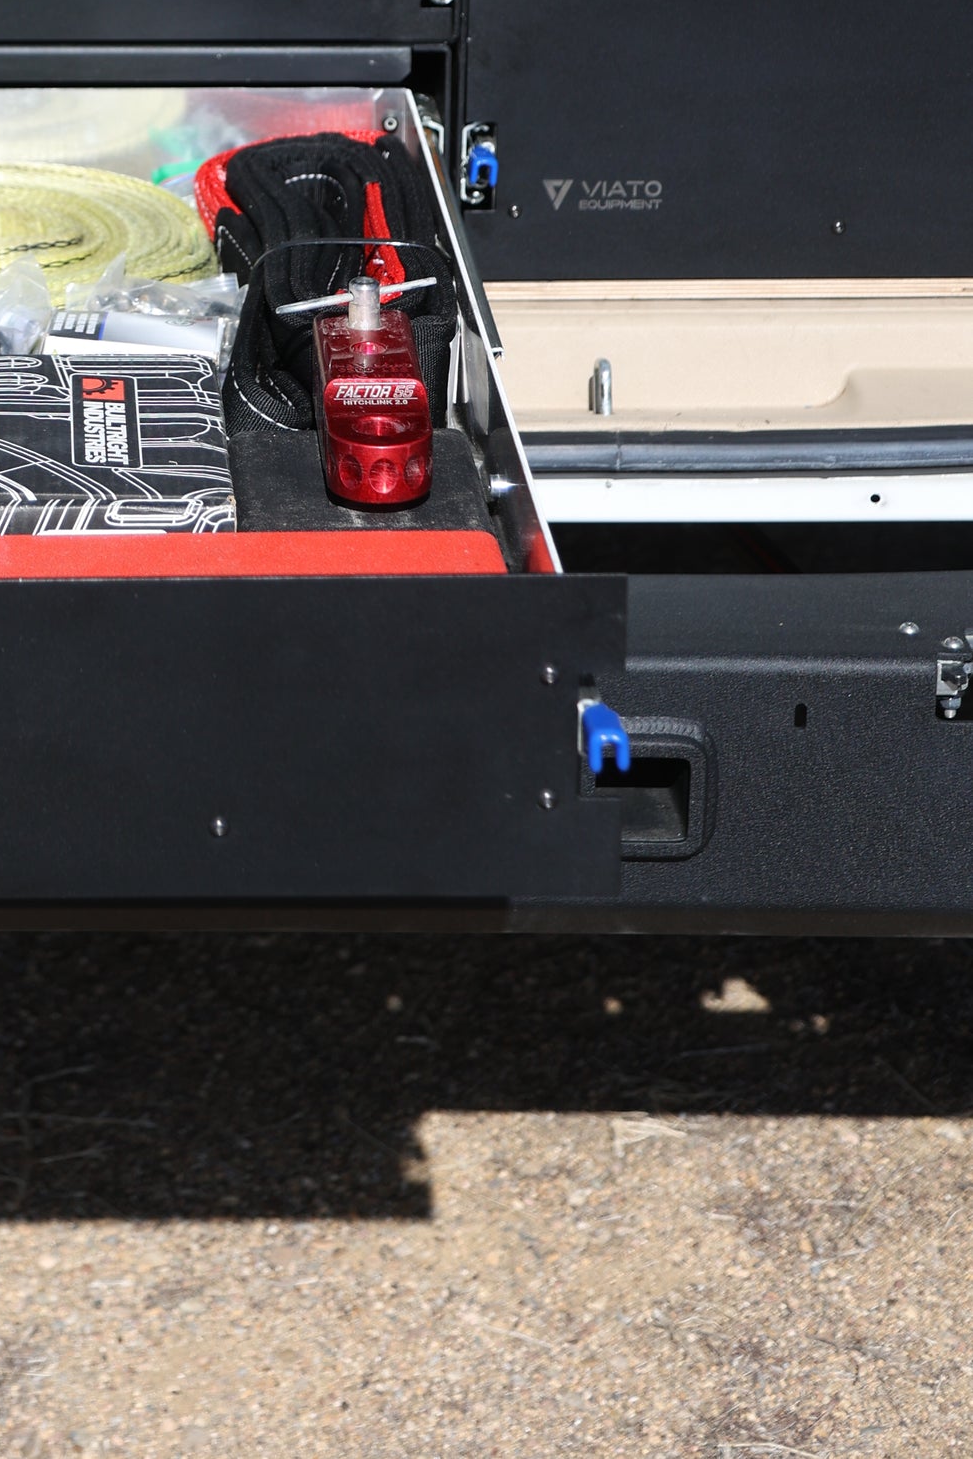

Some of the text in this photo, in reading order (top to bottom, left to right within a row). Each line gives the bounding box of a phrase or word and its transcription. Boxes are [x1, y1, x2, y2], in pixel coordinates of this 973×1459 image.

[581, 180, 662, 197] VIATO
[578, 199, 663, 210] EQUIPMENT
[335, 384, 416, 398] FACTOR 55
[82, 400, 107, 464] INDUSTRIES
[104, 402, 129, 465] BUILTRIGHT
